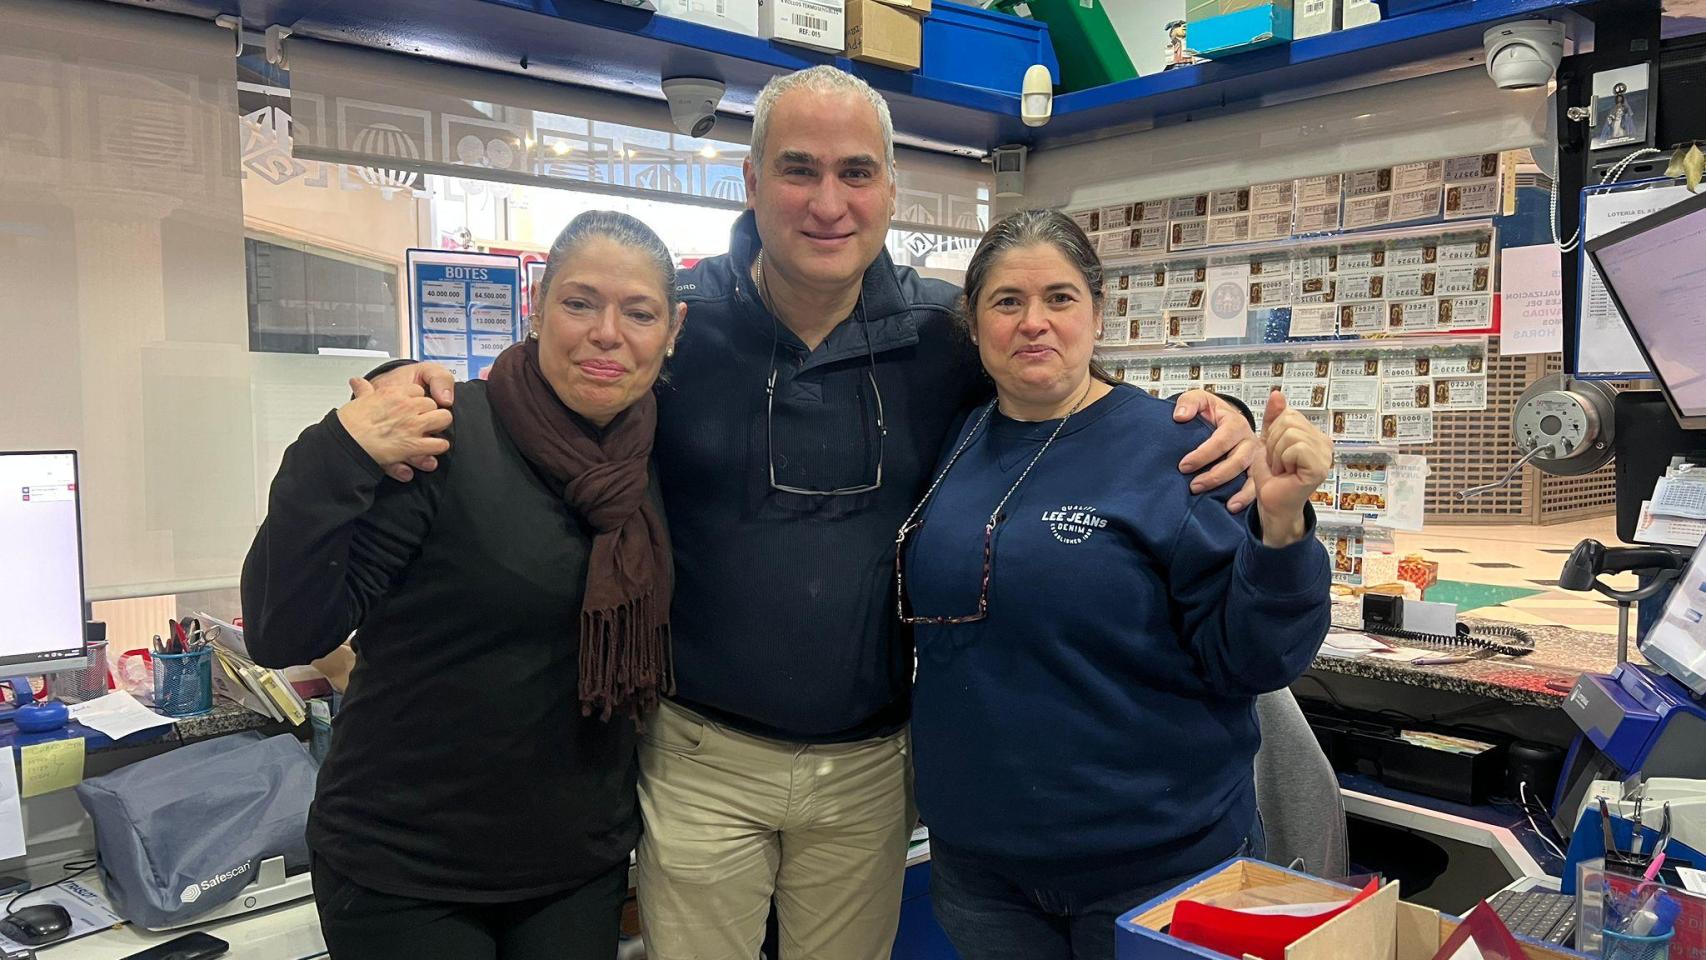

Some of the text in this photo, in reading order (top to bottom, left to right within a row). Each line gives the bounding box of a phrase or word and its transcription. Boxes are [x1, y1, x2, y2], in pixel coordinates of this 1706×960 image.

[446, 267, 487, 279] BOTES
[428, 290, 460, 298] 40.000.000
[1061, 505, 1097, 513] QUALITY
[1042, 511, 1108, 528] LEE JEANS
[1050, 523, 1082, 544] ESTABLISHED
[1058, 523, 1085, 534] DENIM
[201, 860, 250, 892] Safescan
